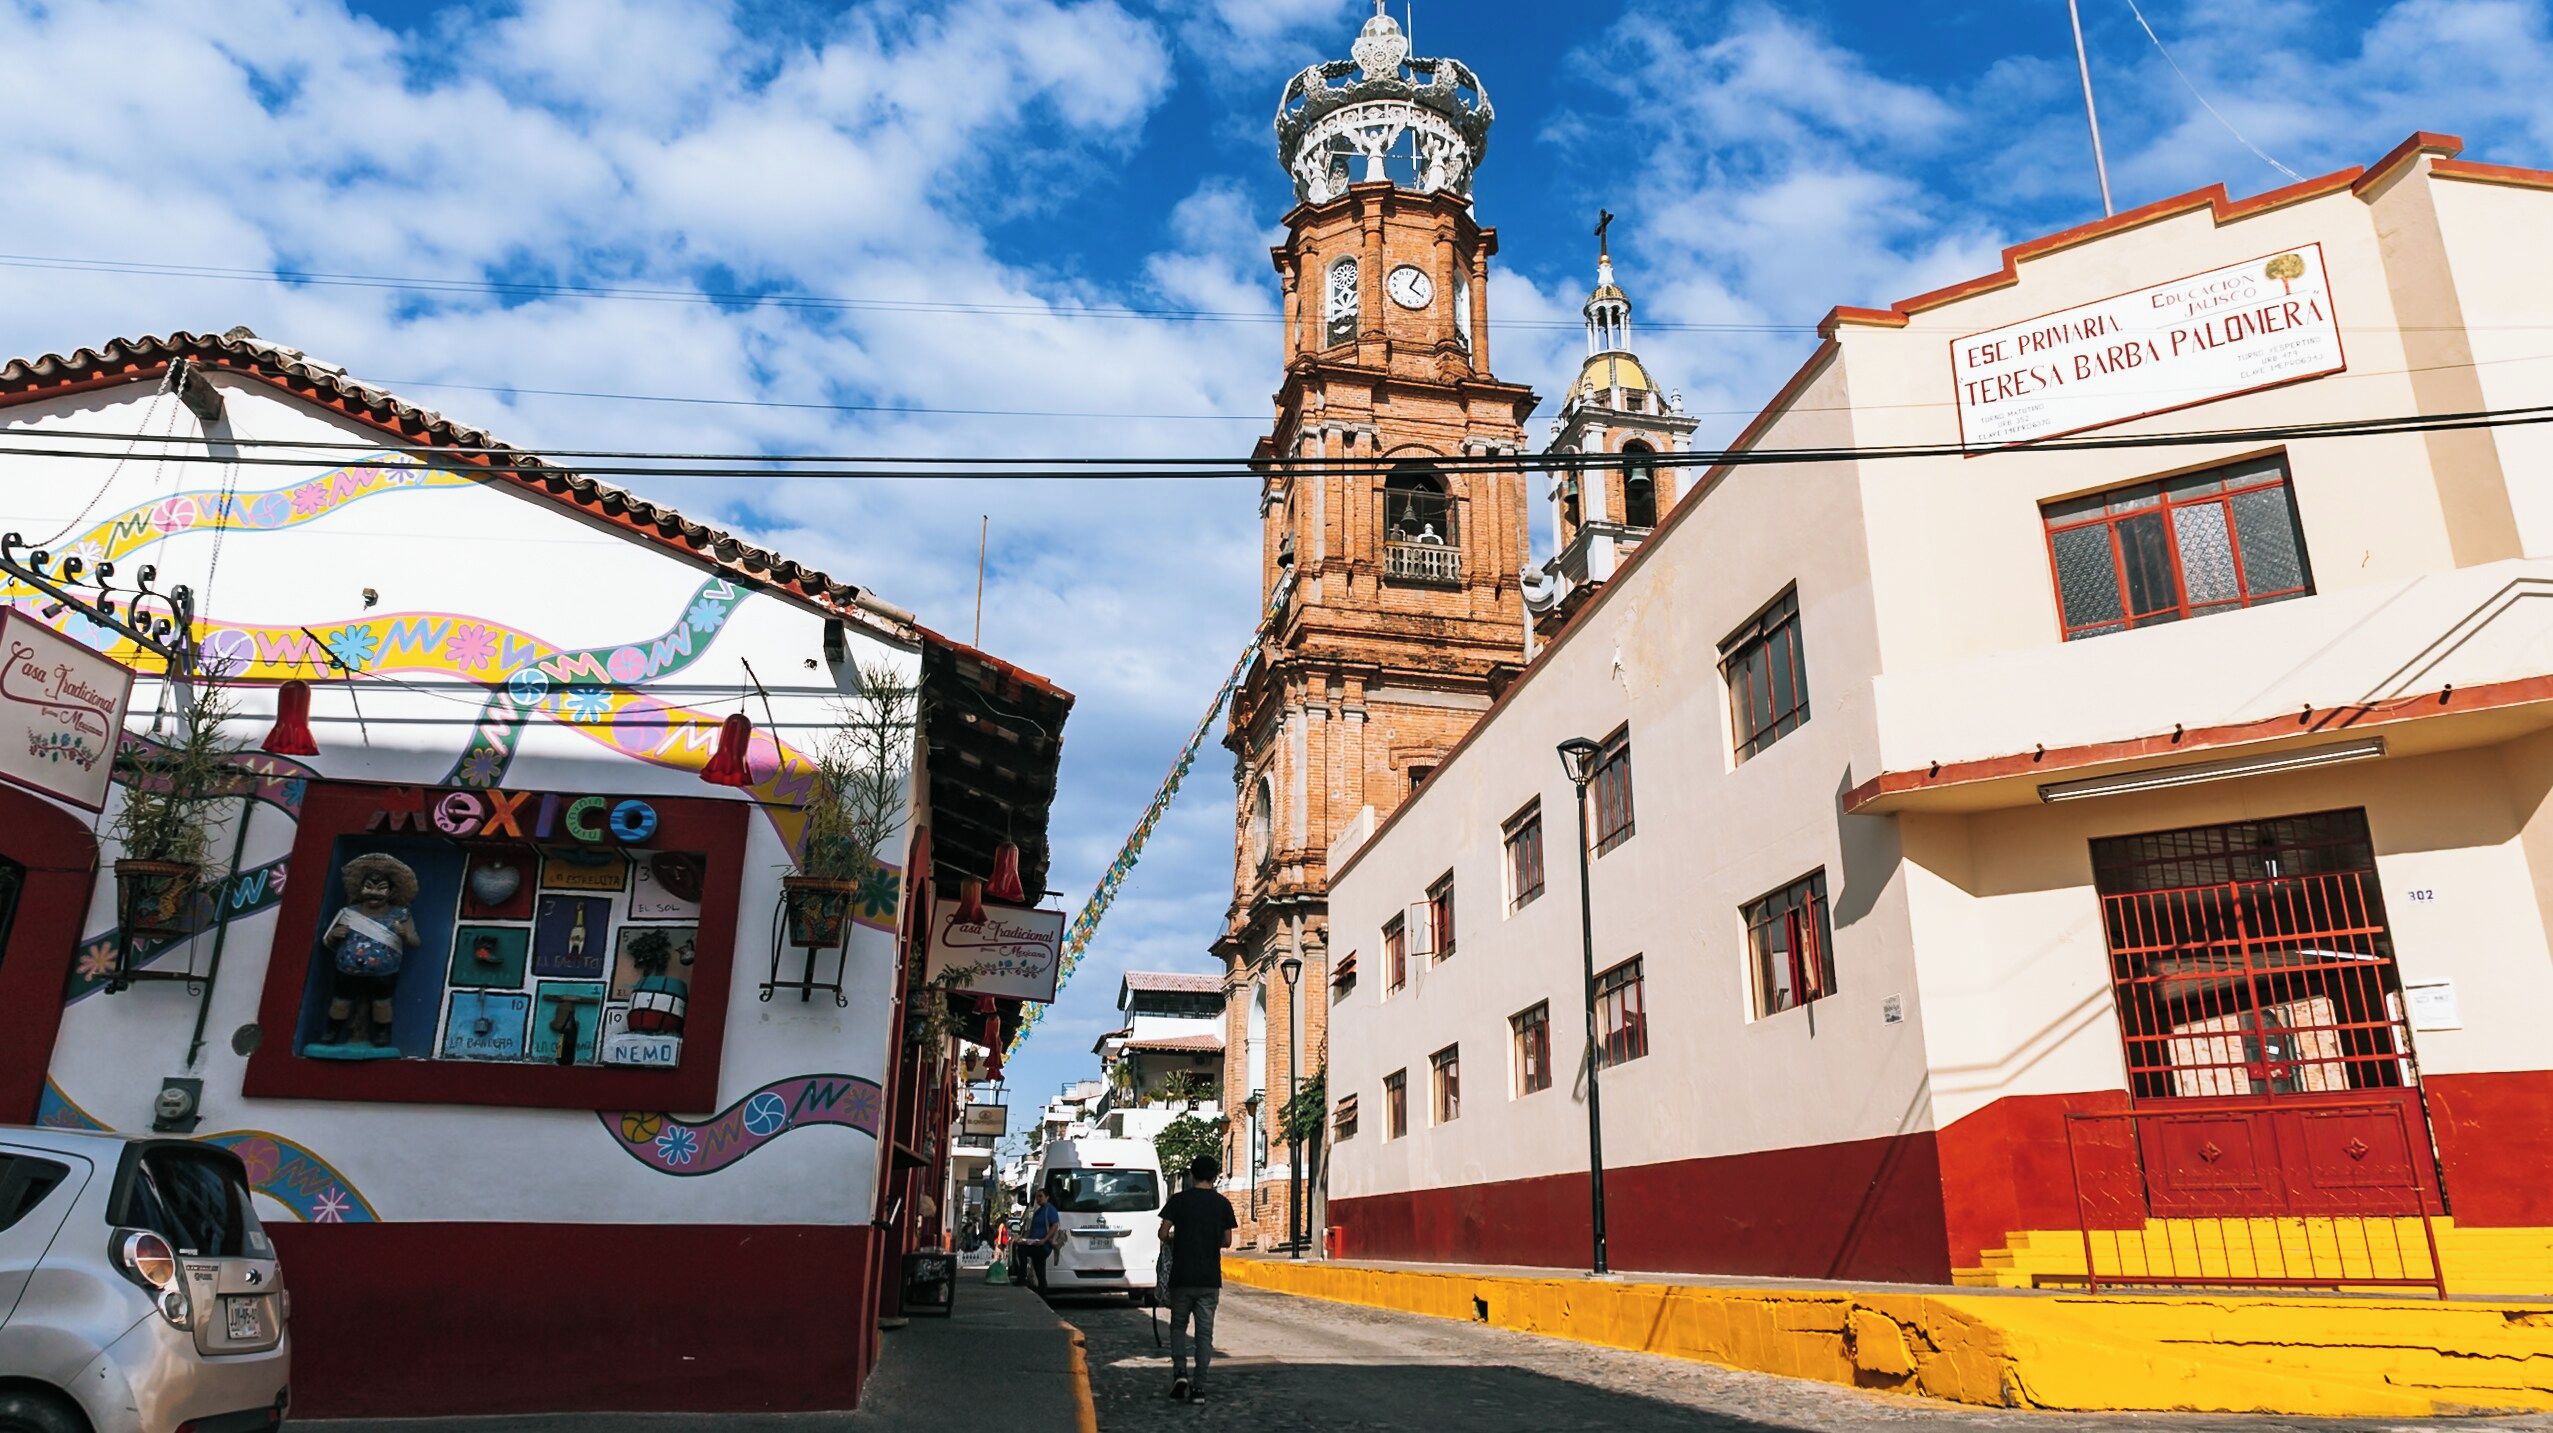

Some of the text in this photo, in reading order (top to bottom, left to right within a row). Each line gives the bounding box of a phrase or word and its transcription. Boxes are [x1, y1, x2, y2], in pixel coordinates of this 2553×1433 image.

[2151, 276, 2255, 308] EDUCACION
[2184, 287, 2256, 317] JALISCO
[1968, 314, 2123, 368] ESC. PRIMARIA.
[2074, 339, 2160, 380] BARBA
[1, 641, 116, 714] Casa Tradicional
[640, 866, 649, 881] 3
[2408, 889, 2434, 901] 302
[639, 903, 680, 912] EL SOL
[983, 920, 1054, 942] Tradicional
[608, 1012, 622, 1025] 10
[615, 1044, 672, 1062] NEMO
